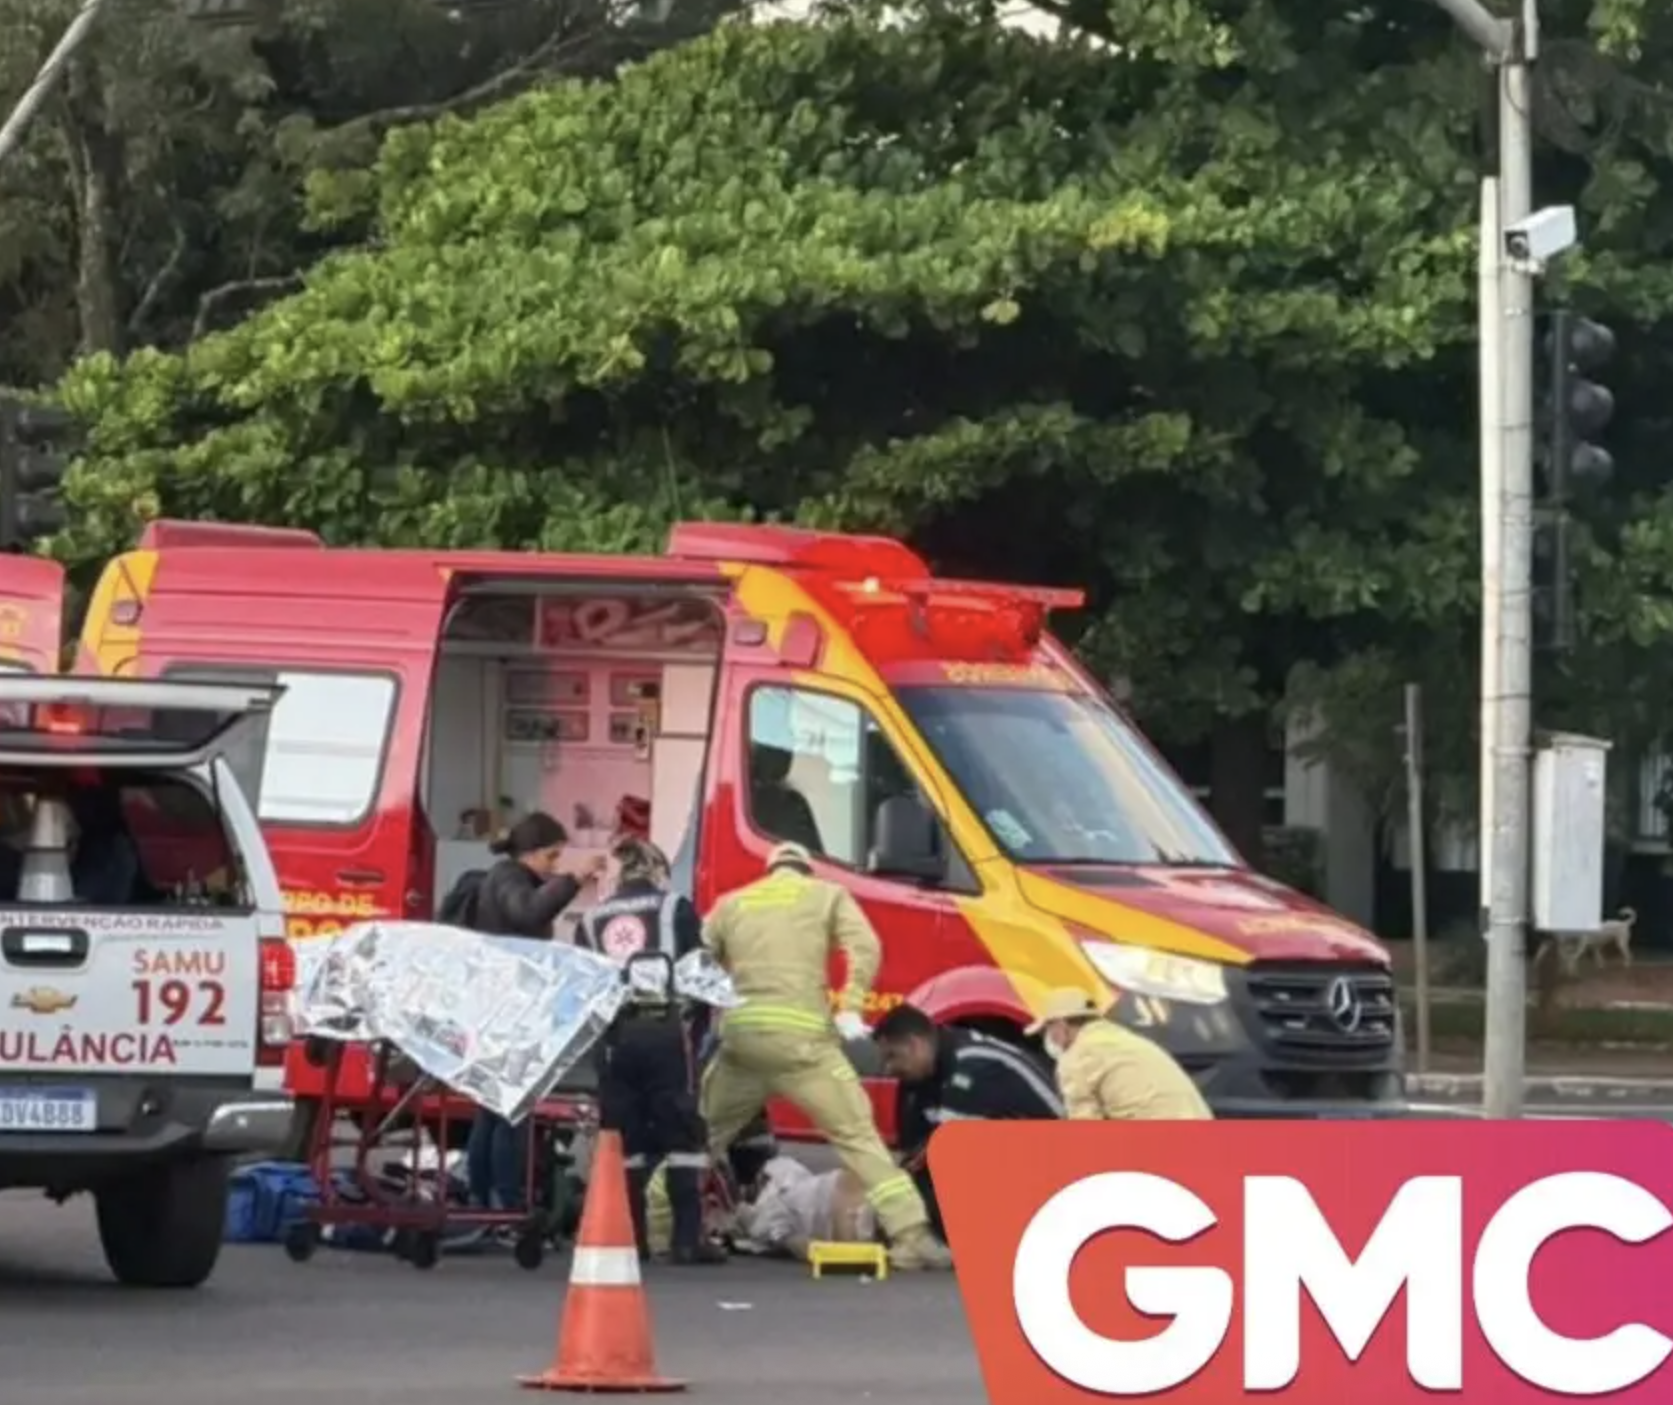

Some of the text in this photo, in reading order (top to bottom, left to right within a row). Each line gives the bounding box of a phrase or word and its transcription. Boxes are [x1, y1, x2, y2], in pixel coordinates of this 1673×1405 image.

[132, 949, 225, 974] SAMU
[131, 980, 226, 1024] 192
[0, 1025, 176, 1063] ULÂNCIA
